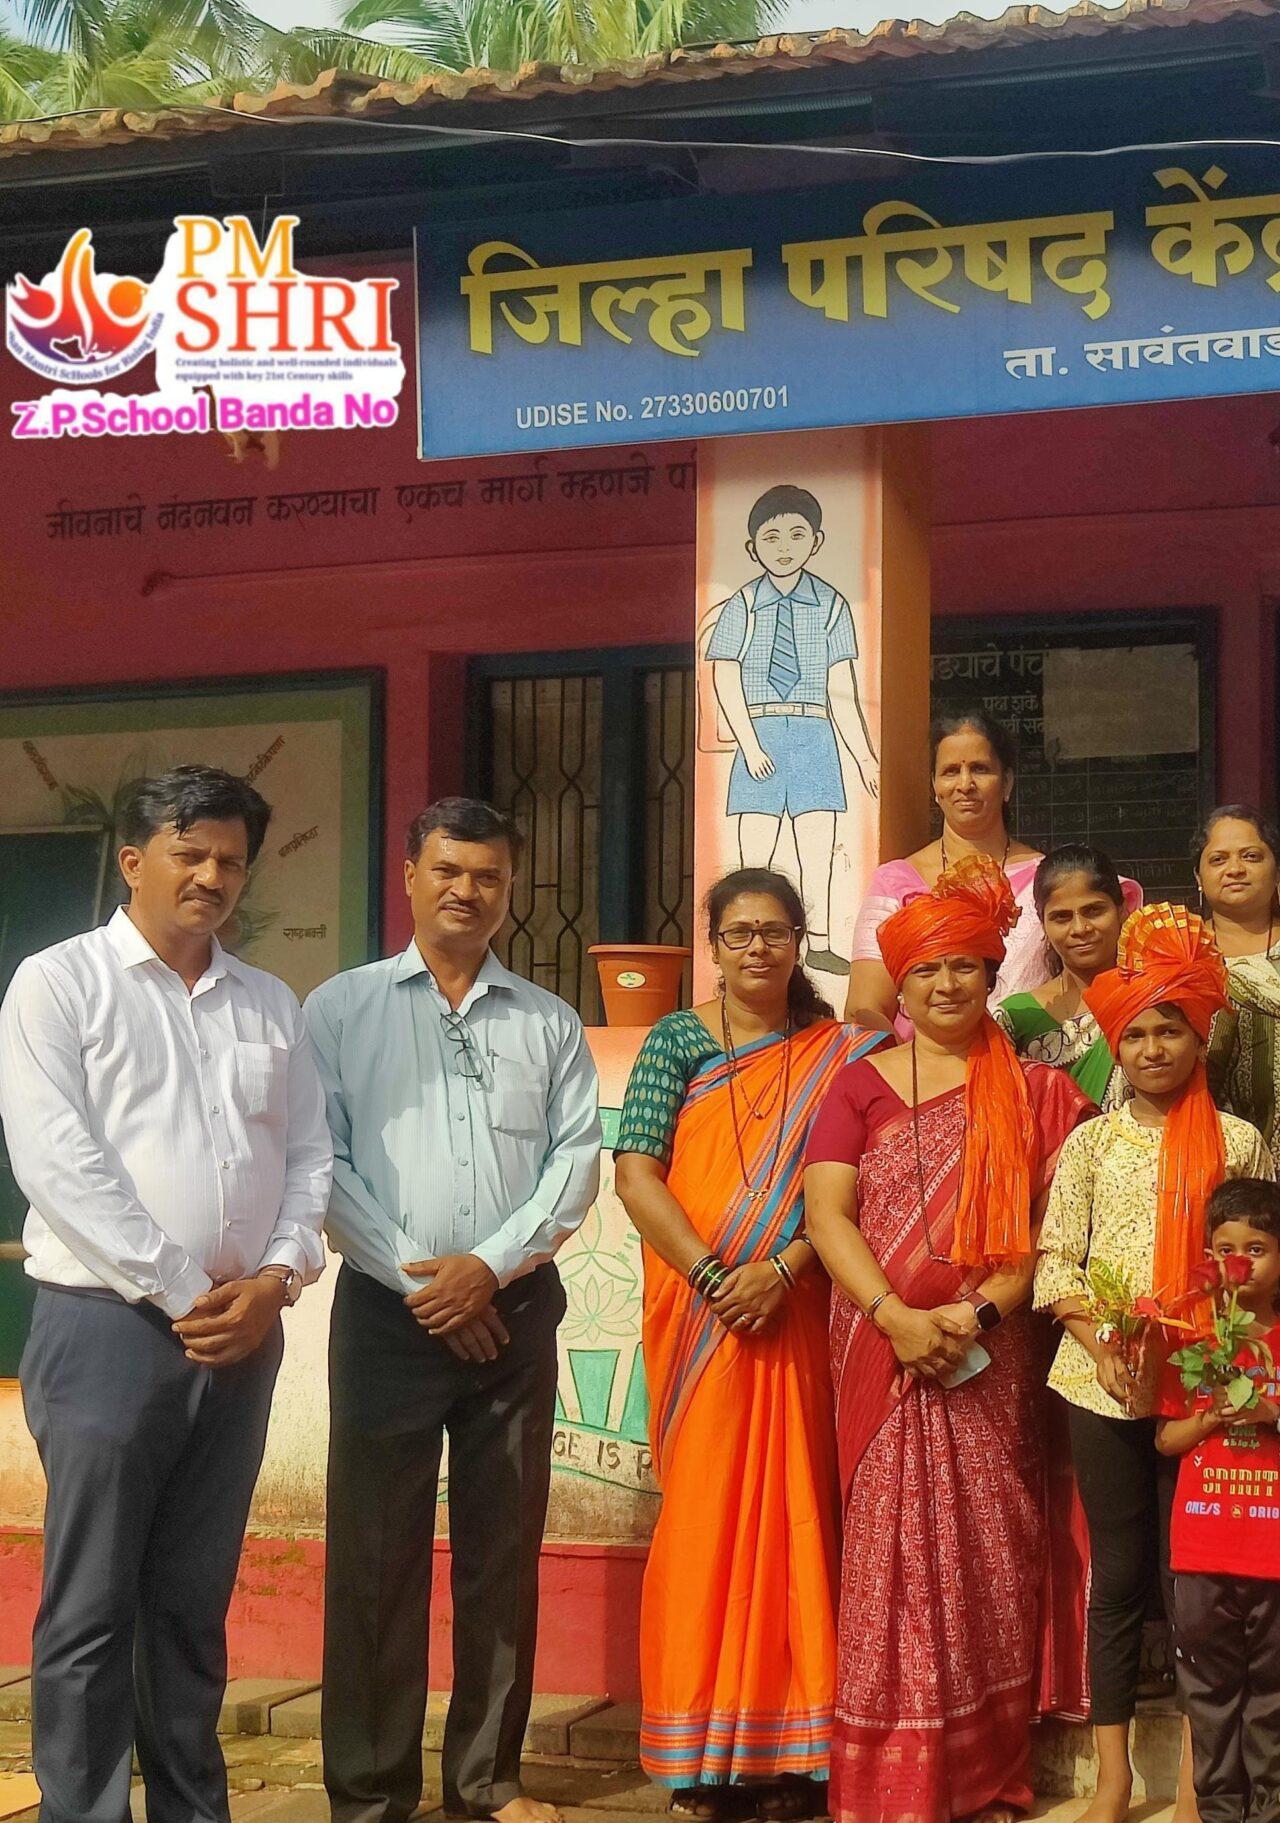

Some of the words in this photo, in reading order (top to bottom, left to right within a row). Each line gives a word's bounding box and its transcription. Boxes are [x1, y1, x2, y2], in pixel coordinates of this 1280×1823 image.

[461, 241, 752, 356] जिल्हा
[781, 201, 1114, 319] परिषद
[1003, 346, 1069, 379] ता.
[516, 402, 588, 429] UDISE
[596, 400, 633, 422] No.
[641, 385, 788, 419] 27330600701
[395, 480, 466, 524] एकच
[557, 451, 655, 507] म्हणजे
[596, 1440, 621, 1470] IS
